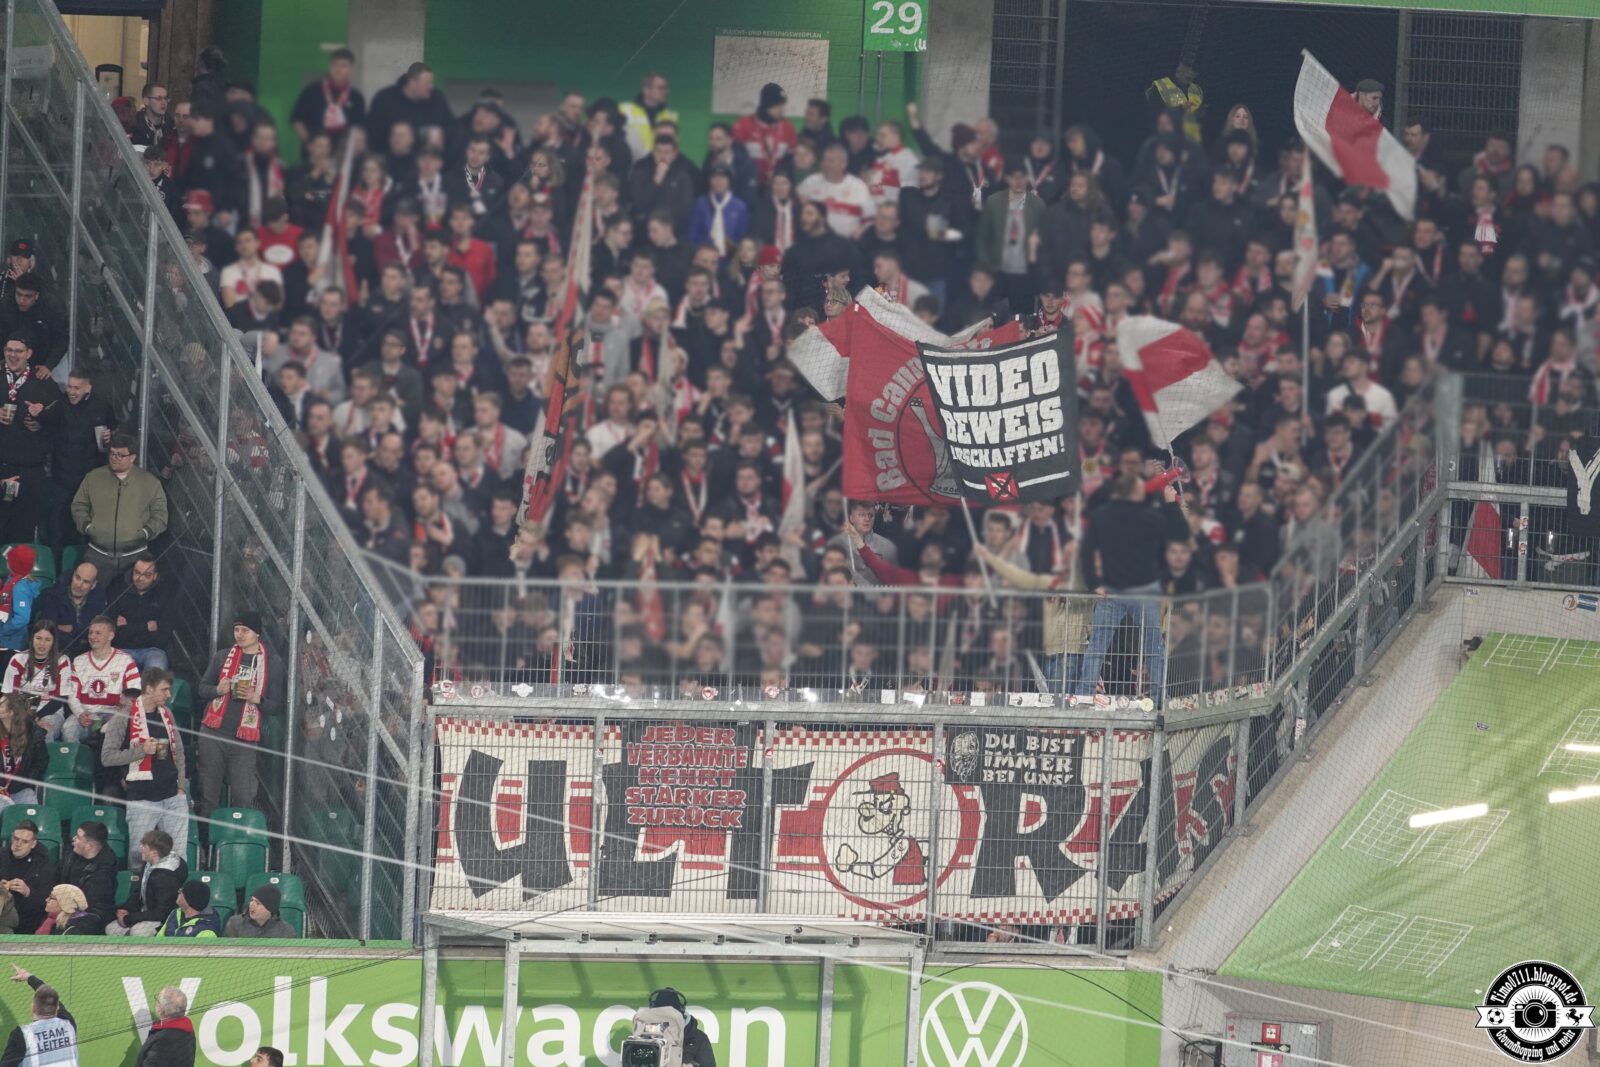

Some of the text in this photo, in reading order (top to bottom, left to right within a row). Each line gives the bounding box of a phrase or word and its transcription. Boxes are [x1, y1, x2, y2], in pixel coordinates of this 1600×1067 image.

[870, 1, 922, 35] 29
[926, 349, 1060, 407] VIDEO
[940, 396, 1064, 445] BEWEIS
[867, 427, 907, 493] Bad
[626, 741, 748, 768] VERBANNTE
[984, 733, 1076, 754] DU BIST
[984, 750, 1073, 772] IMMER
[637, 766, 737, 787] KEHRT
[982, 769, 1015, 783] BEI
[627, 805, 743, 828] ZURÜCK
[34, 1027, 68, 1042] TEAM-
[37, 1036, 71, 1052] LEITER
